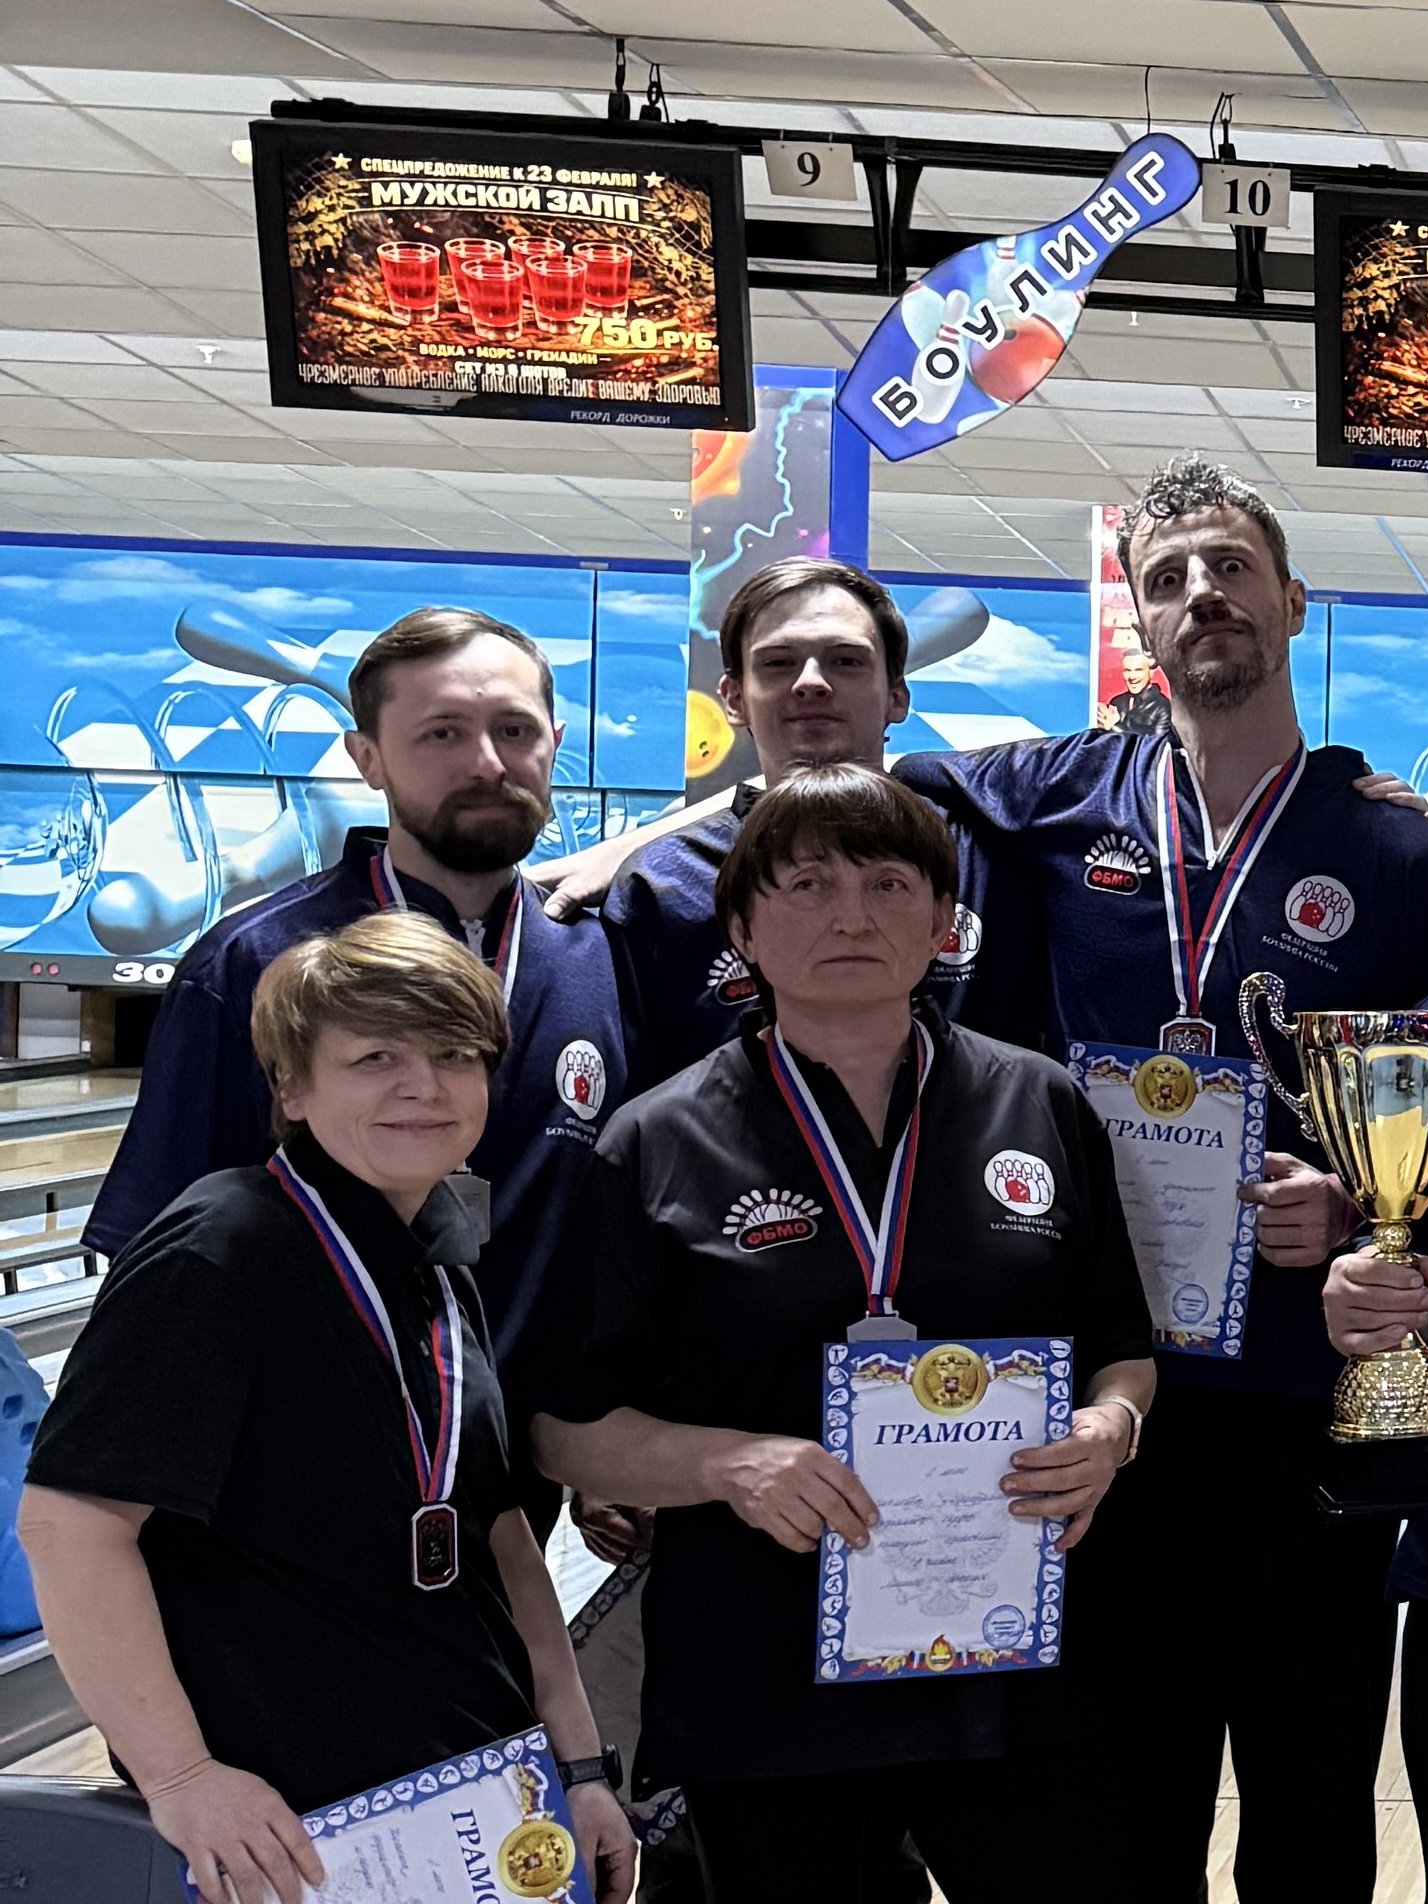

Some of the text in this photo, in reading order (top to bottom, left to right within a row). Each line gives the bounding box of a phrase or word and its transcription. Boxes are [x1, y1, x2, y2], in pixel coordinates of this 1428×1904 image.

[514, 168, 524, 180] К
[528, 166, 552, 181] 23
[556, 169, 636, 187] ФЕВРАЛЯ!
[799, 148, 821, 189] 9
[370, 182, 639, 222] МУЖСКОЙ ЗАЛП
[1224, 177, 1272, 220] 10
[874, 153, 1166, 426] БОУЛИНГ
[577, 318, 719, 351] 750 РУБ.
[1103, 1116, 1225, 1149] ГРАМОТА
[746, 1223, 808, 1244] ФБМО
[874, 1420, 1025, 1446] ГРАМОТА
